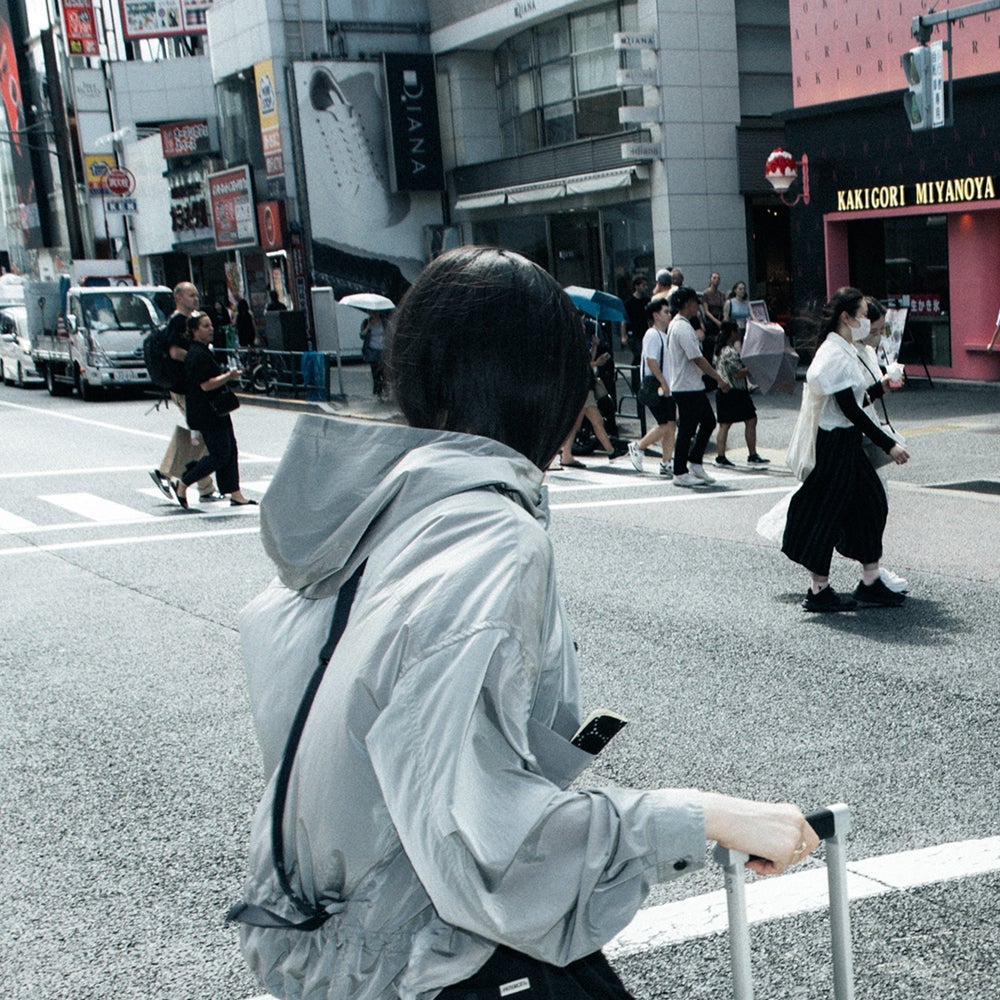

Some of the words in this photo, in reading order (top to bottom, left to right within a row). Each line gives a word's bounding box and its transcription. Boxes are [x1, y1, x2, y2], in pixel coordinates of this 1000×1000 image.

[401, 70, 427, 175] DIANA
[837, 184, 905, 211] KAKIGORI
[915, 175, 995, 205] MIYANOYA
